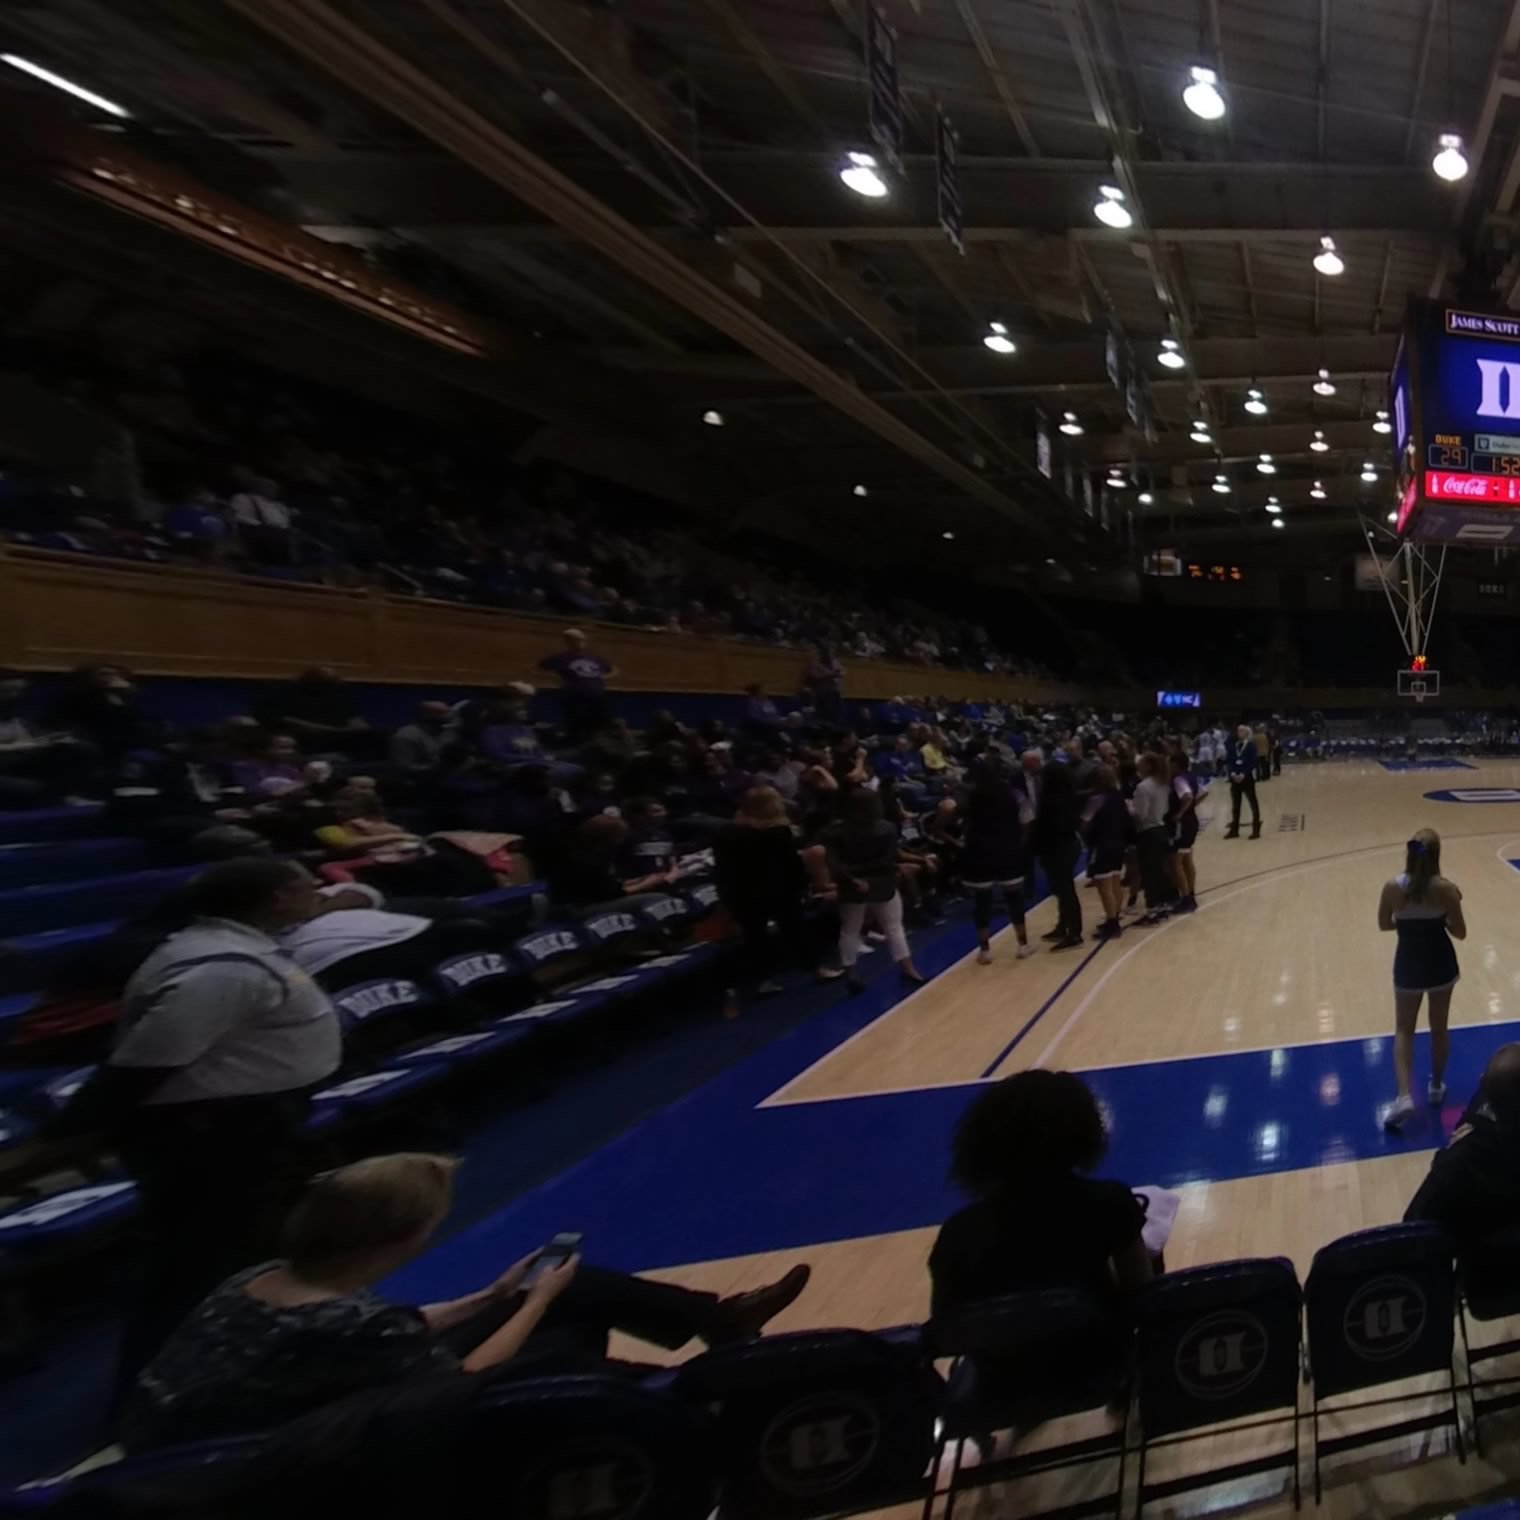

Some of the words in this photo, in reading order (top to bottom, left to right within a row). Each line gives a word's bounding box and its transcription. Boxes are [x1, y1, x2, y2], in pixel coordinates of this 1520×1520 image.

[1450, 314, 1483, 330] JAMES
[1485, 319, 1519, 335] SCOTT
[1435, 434, 1462, 446] DUKE
[1441, 447, 1461, 465] 29
